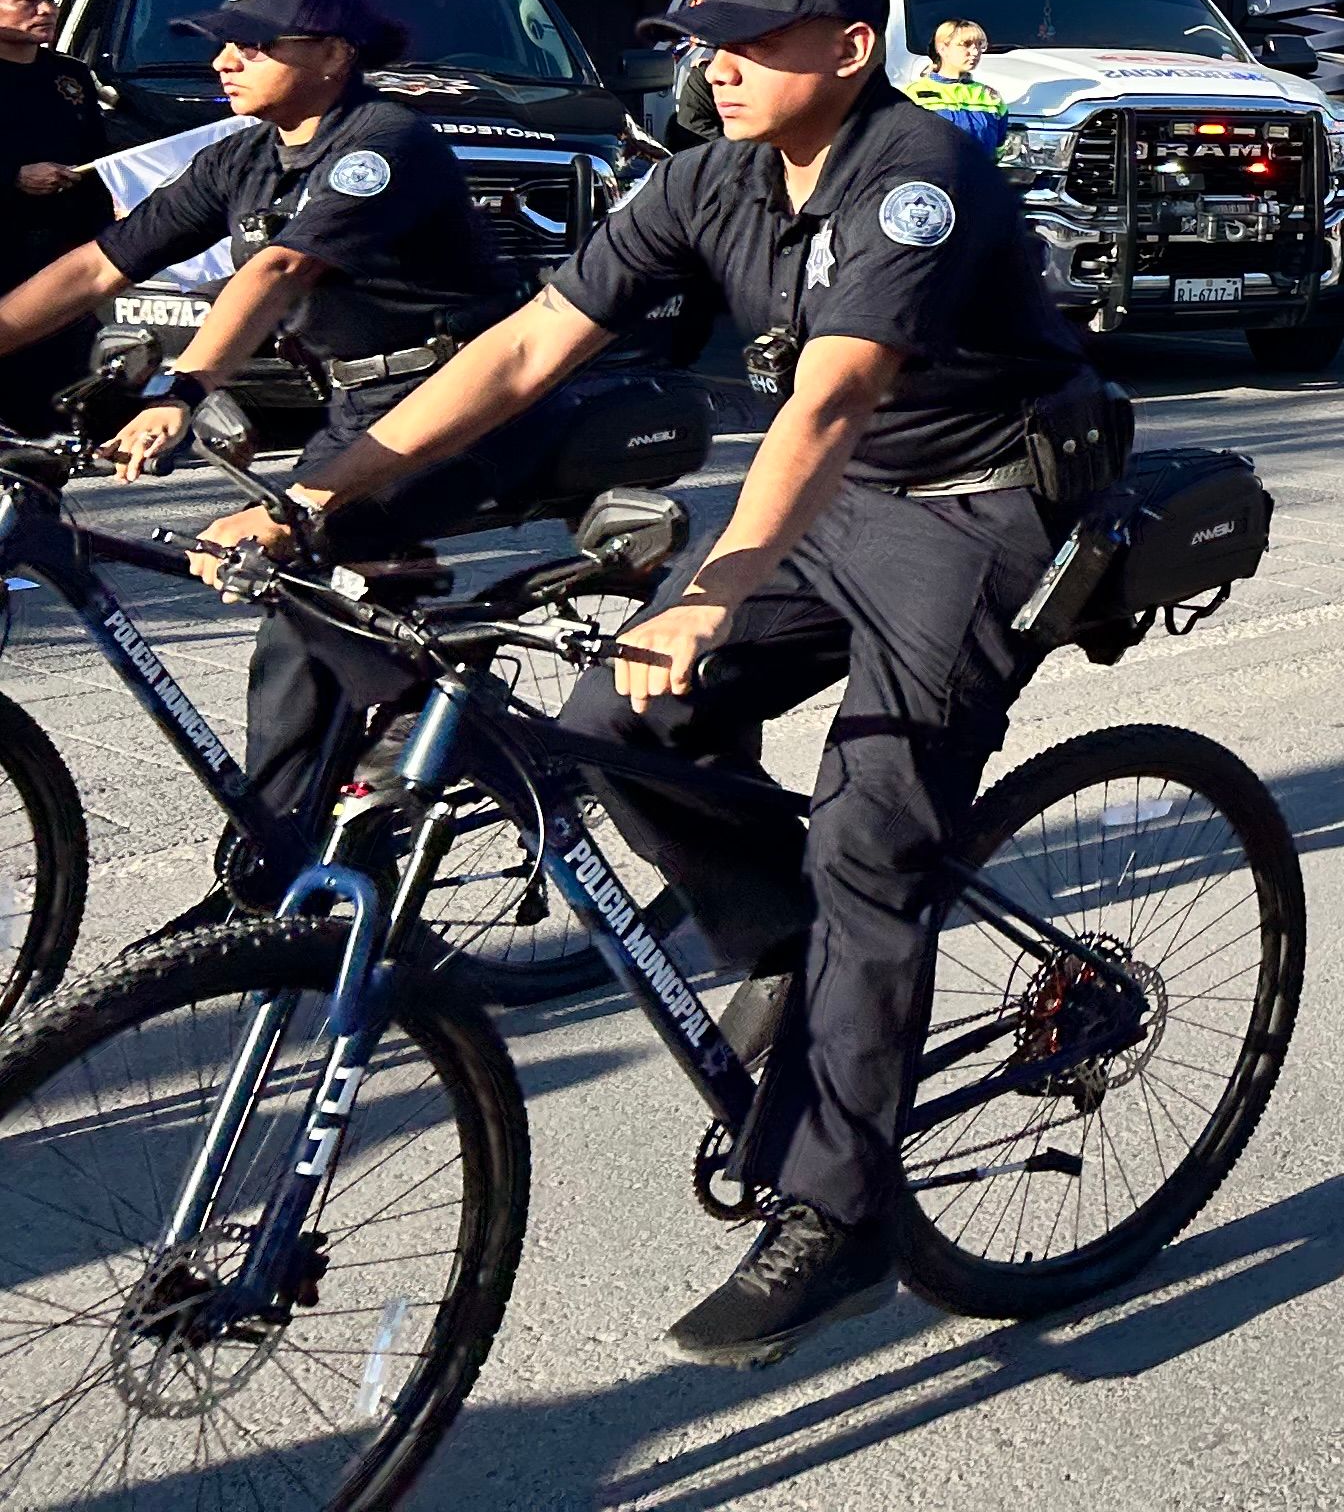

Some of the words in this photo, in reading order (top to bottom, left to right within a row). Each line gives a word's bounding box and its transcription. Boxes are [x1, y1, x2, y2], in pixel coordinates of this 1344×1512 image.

[1156, 142, 1253, 157] RAM
[103, 609, 162, 685] POLICIA
[153, 675, 229, 773] MUNICIPAL
[563, 838, 636, 937] POLICIA
[623, 921, 712, 1049] MUNICIPAL
